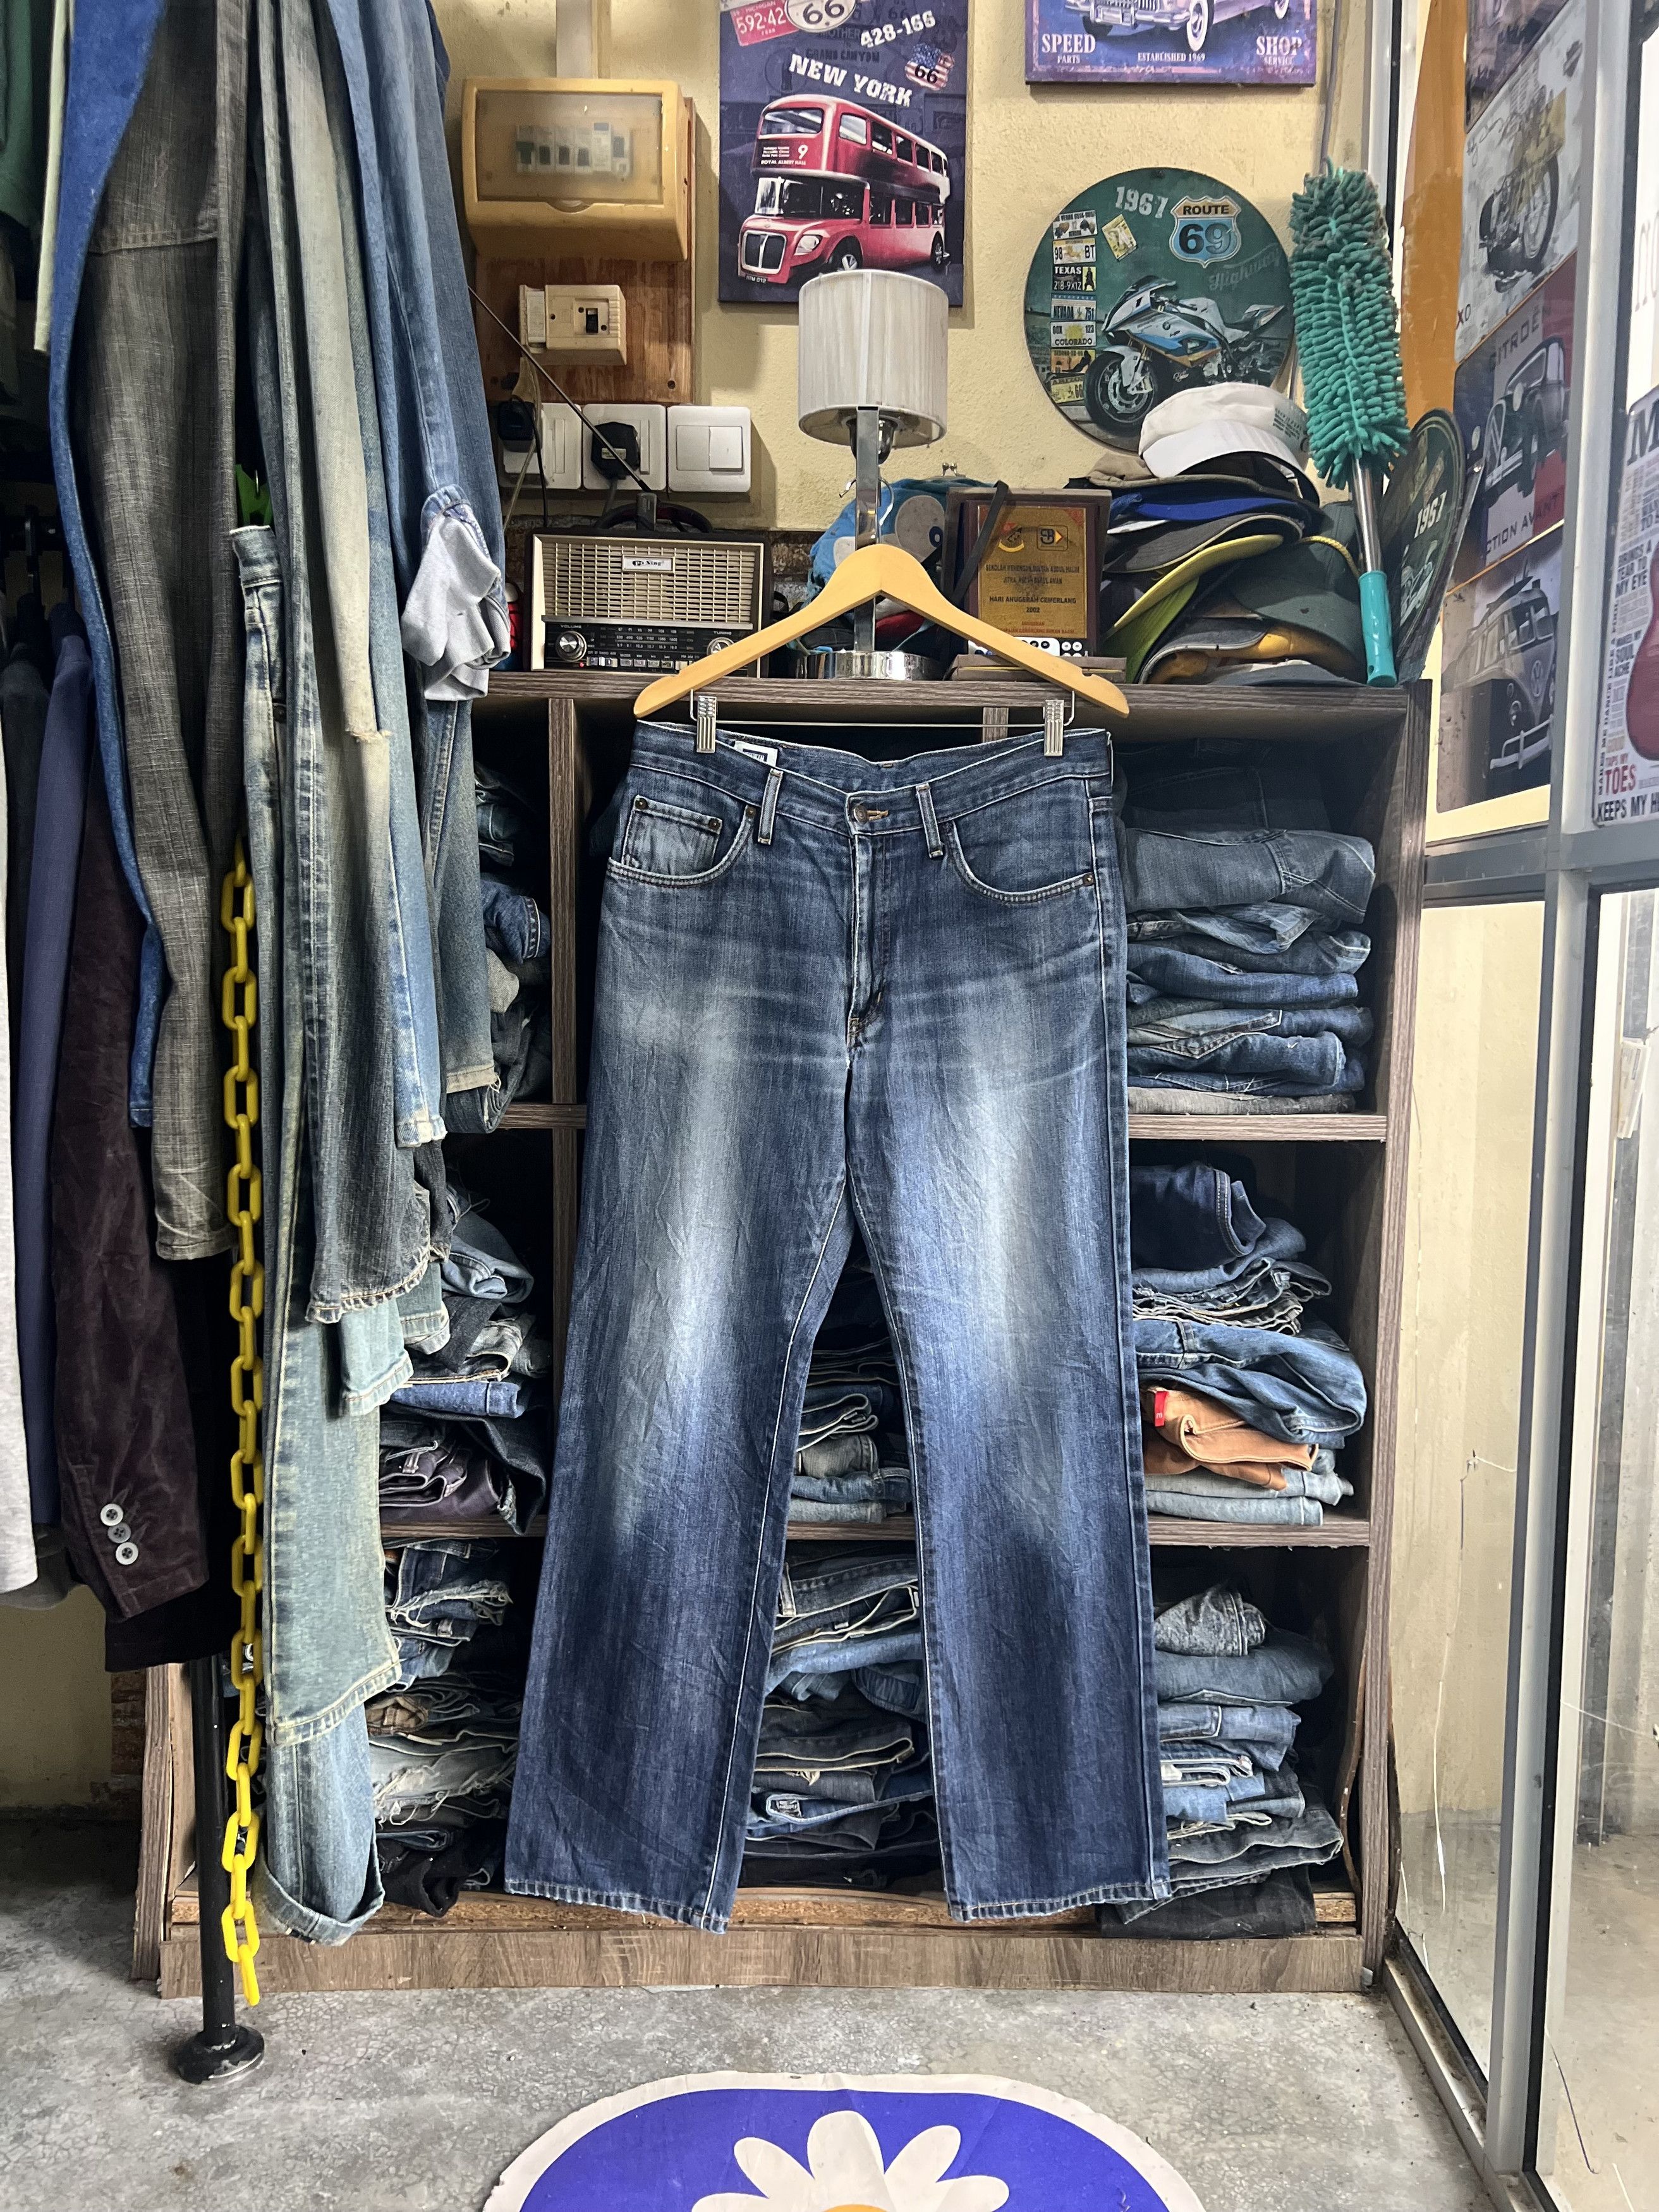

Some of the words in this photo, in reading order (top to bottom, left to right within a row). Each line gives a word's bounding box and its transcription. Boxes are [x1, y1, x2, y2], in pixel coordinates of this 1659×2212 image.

[803, 0, 845, 25] 66
[860, 10, 936, 48] 428-166
[1042, 33, 1096, 53] SPEED
[1256, 35, 1302, 56] SHOP
[1057, 55, 1080, 64] PARTS
[1138, 51, 1186, 62] ESTABLISHED
[1188, 52, 1206, 62] 1969
[789, 54, 847, 87] NEW
[854, 73, 913, 107] YORK
[914, 64, 939, 83] 66
[798, 144, 808, 159] 9
[1115, 186, 1169, 219] 1967
[1182, 205, 1229, 215] ROUTE
[1179, 223, 1231, 254] 69
[1054, 247, 1063, 260] 98
[1085, 245, 1095, 258] BT
[1054, 266, 1082, 274] TEXAS
[1414, 490, 1448, 538] 1967
[1631, 569, 1648, 590] EYE
[1605, 763, 1637, 796] TOES
[1596, 798, 1627, 823] KEEPS
[1631, 794, 1648, 817] MY
